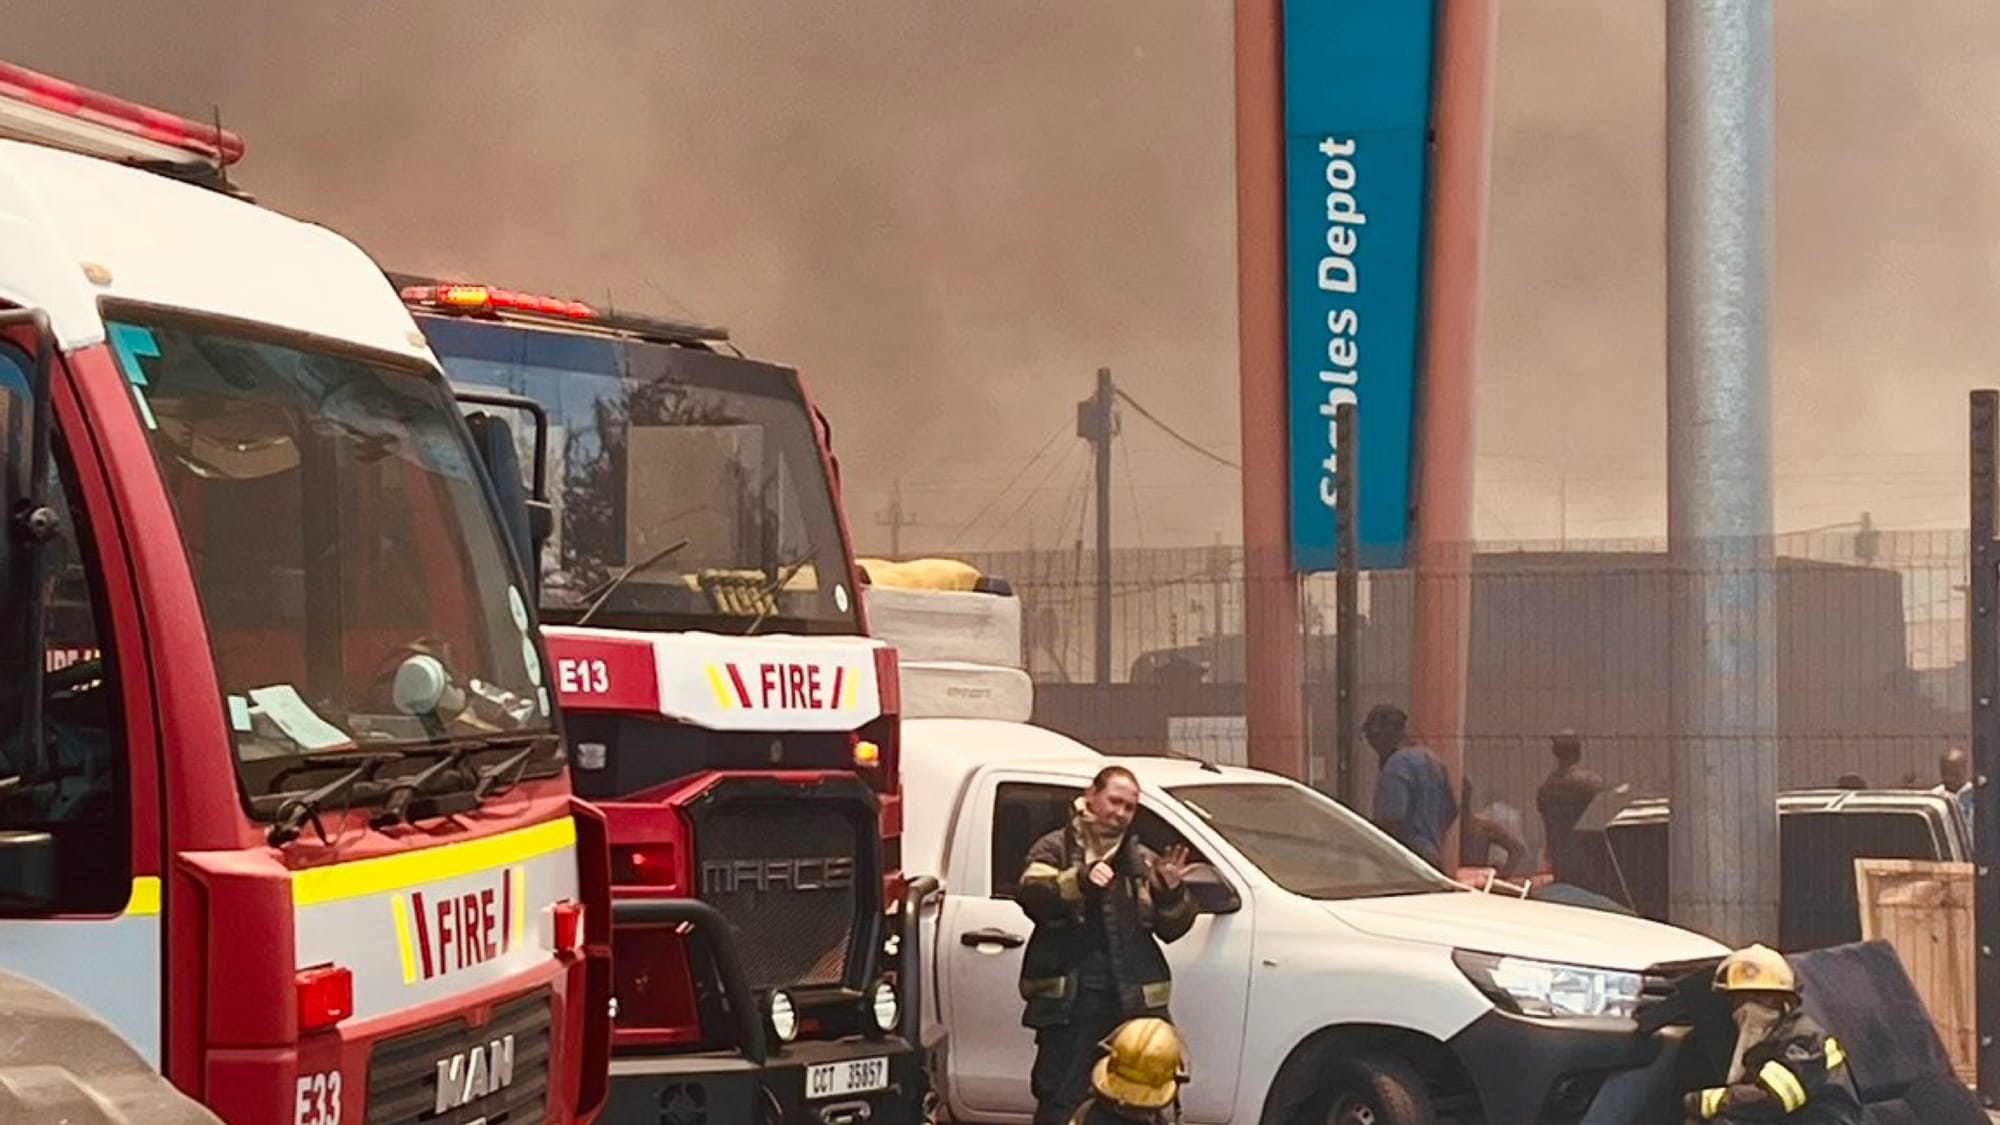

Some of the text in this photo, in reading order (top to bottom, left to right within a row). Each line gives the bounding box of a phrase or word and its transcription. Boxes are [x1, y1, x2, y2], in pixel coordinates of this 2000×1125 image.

[1318, 137, 1366, 293] Depot
[558, 659, 610, 693] E13
[760, 664, 822, 709] FIRE
[437, 888, 496, 975] FIRE
[295, 1070, 341, 1125] E33
[434, 1035, 514, 1115] MAN
[813, 1066, 835, 1094] CCT
